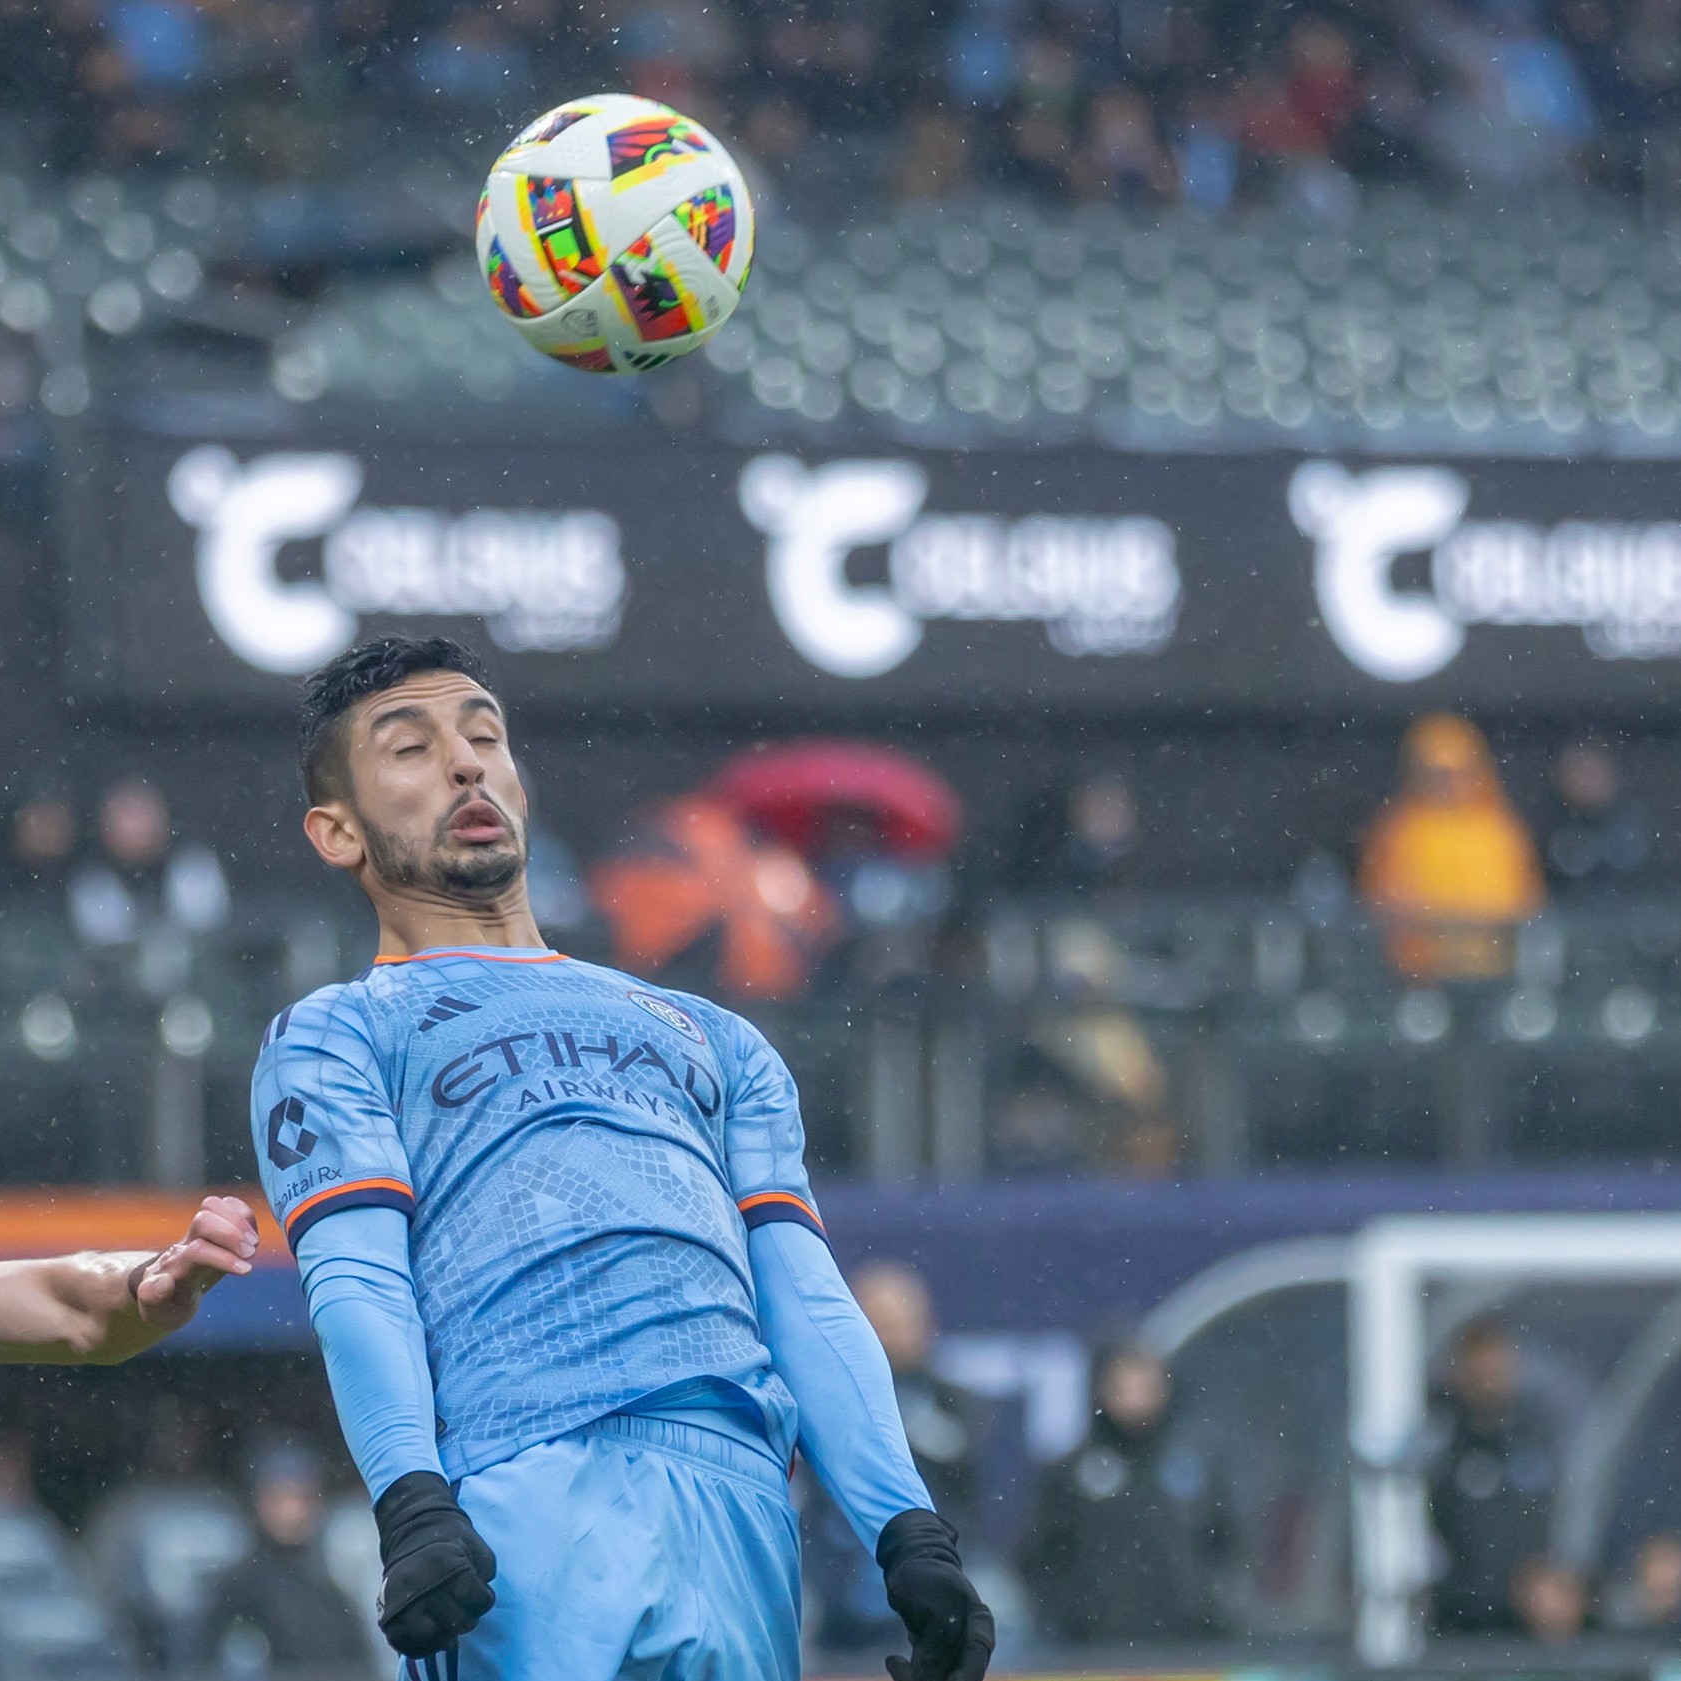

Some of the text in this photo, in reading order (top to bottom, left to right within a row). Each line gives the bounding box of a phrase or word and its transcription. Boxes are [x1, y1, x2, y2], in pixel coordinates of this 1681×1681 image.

[431, 1032, 721, 1118] ETIHAD
[518, 1079, 681, 1126] AIRWAYS
[274, 1165, 343, 1218] pital Rx
